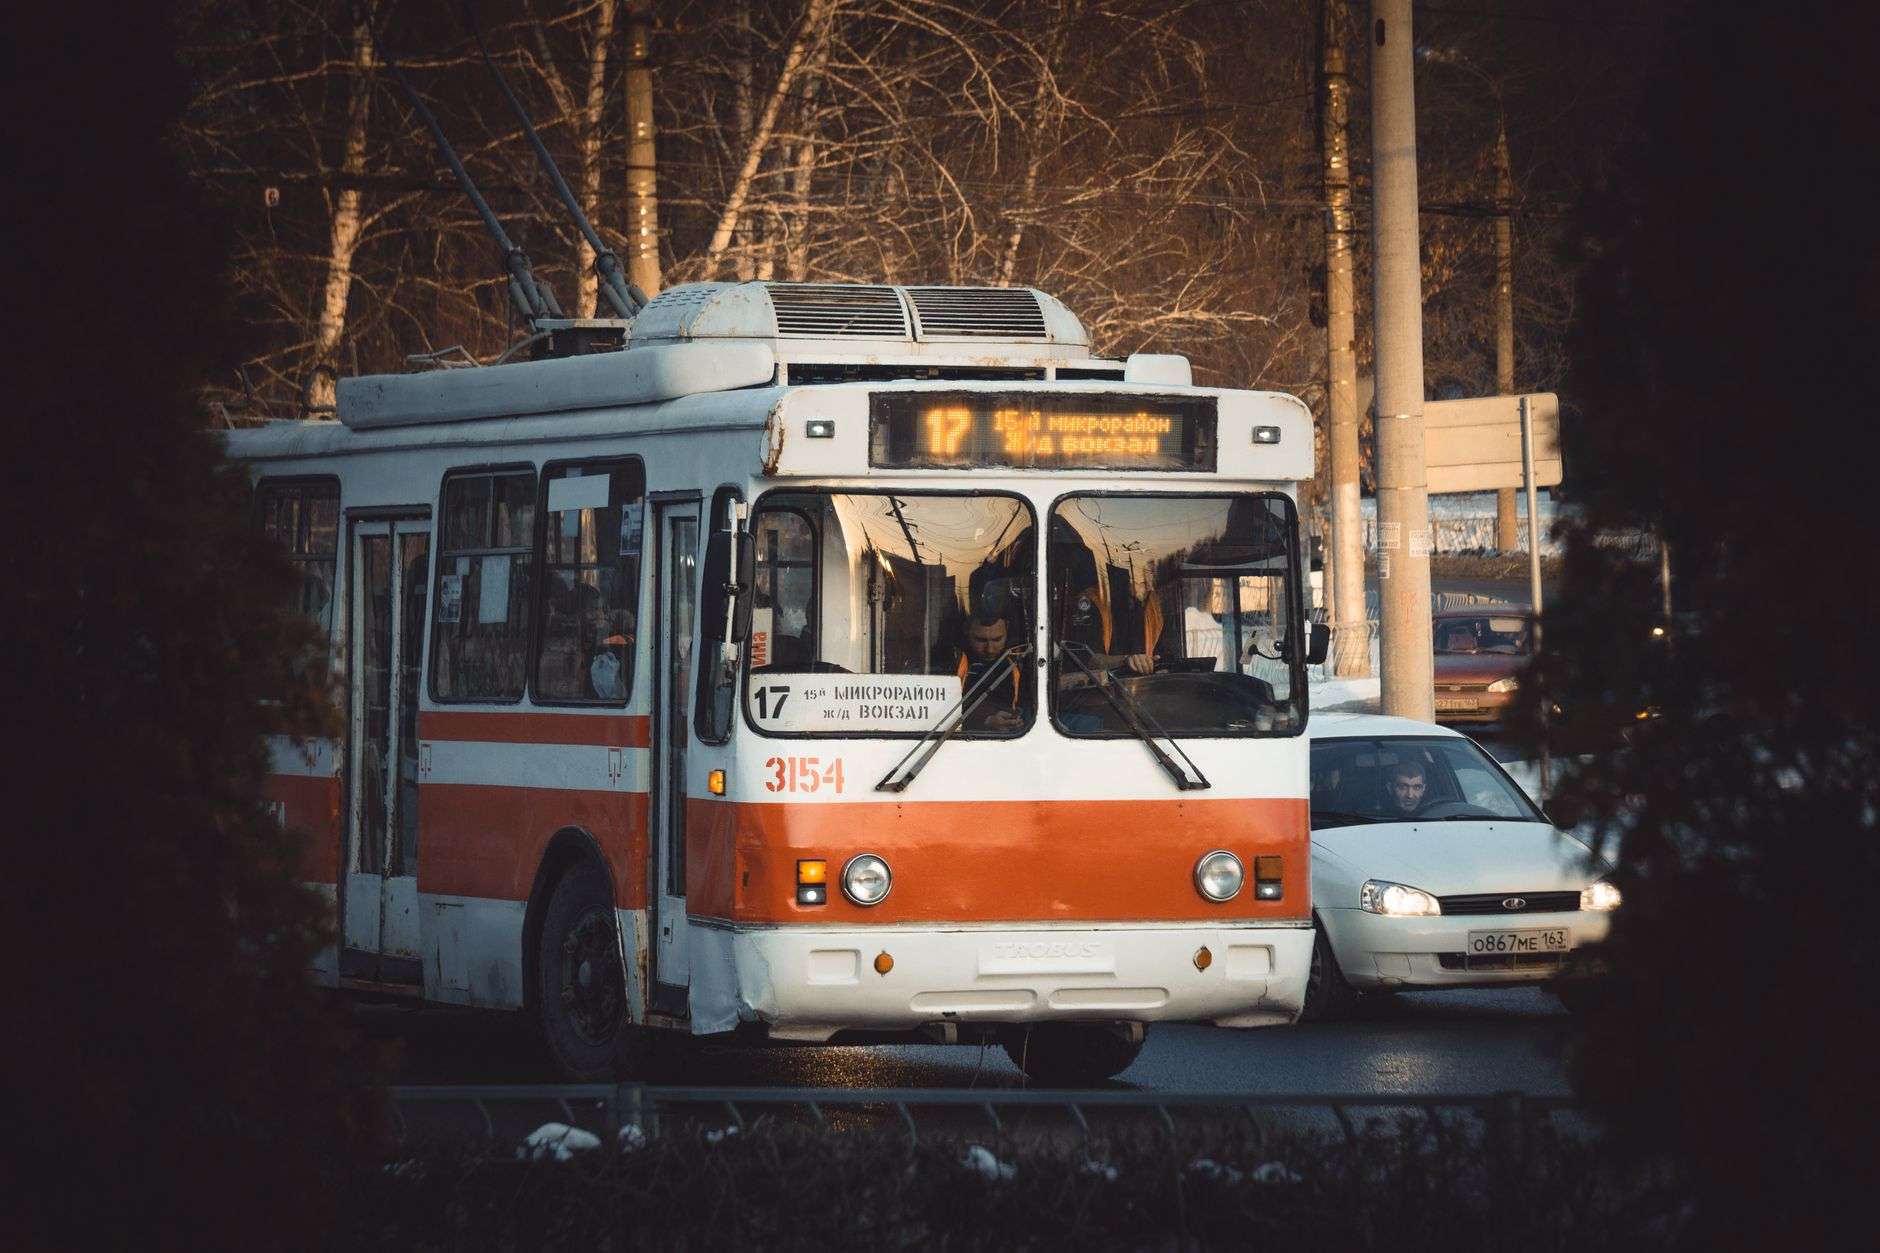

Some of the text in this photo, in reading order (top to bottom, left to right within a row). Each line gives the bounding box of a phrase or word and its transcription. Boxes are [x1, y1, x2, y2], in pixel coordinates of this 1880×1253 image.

[926, 408, 971, 454] 17
[1048, 412, 1170, 433] микрорайон
[754, 685, 790, 719] 17
[834, 684, 946, 701] МИКРОРАЙОН
[859, 705, 929, 720] ВОКЗАЛ
[765, 757, 845, 793] 3154
[1542, 931, 1563, 945] 163
